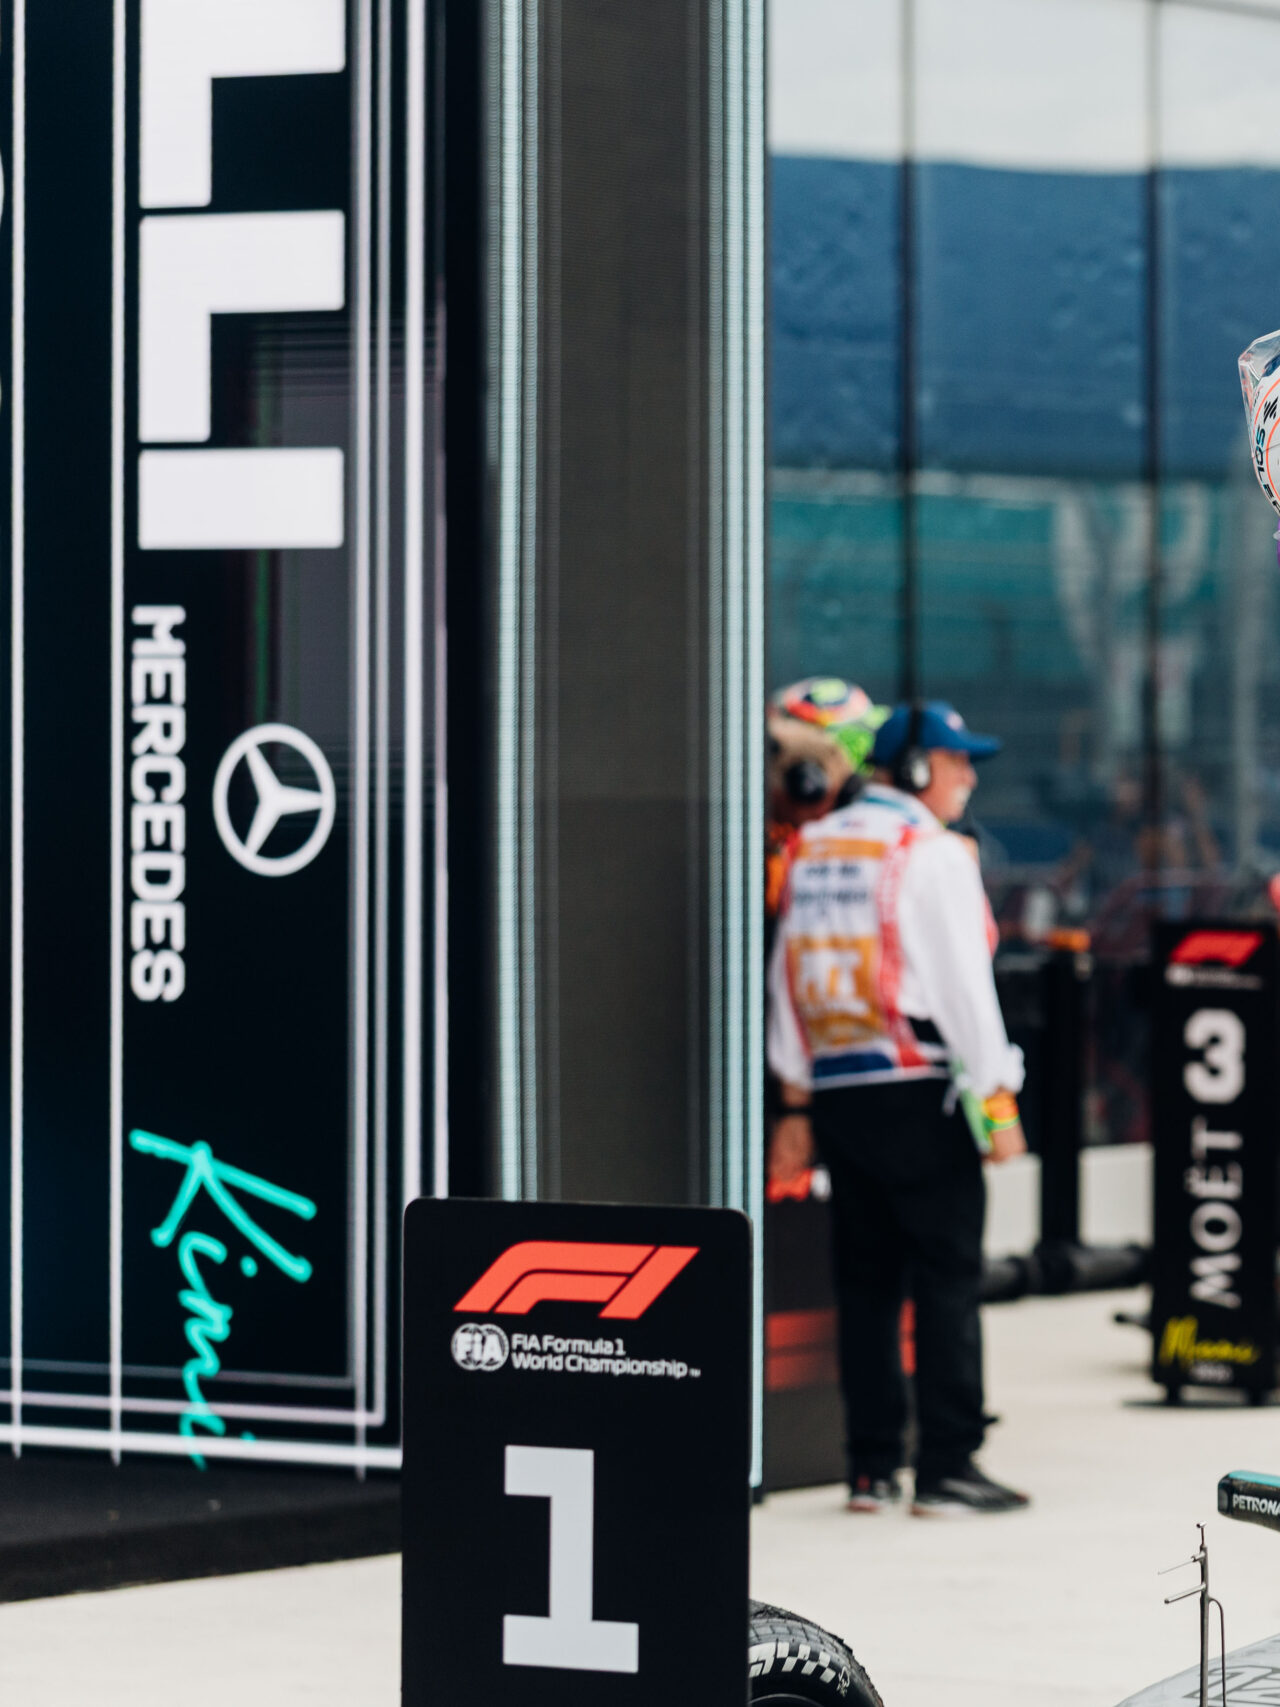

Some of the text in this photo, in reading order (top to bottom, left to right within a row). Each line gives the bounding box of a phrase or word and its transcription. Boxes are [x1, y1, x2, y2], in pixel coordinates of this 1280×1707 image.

[131, 604, 187, 1002] MERCEDES
[1183, 1009, 1246, 1104] 3
[129, 1128, 317, 1471] Kimi
[453, 1240, 700, 1319] F1
[511, 1333, 626, 1356] FIA Formula 1
[511, 1352, 563, 1372] World
[503, 1445, 639, 1673] 1
